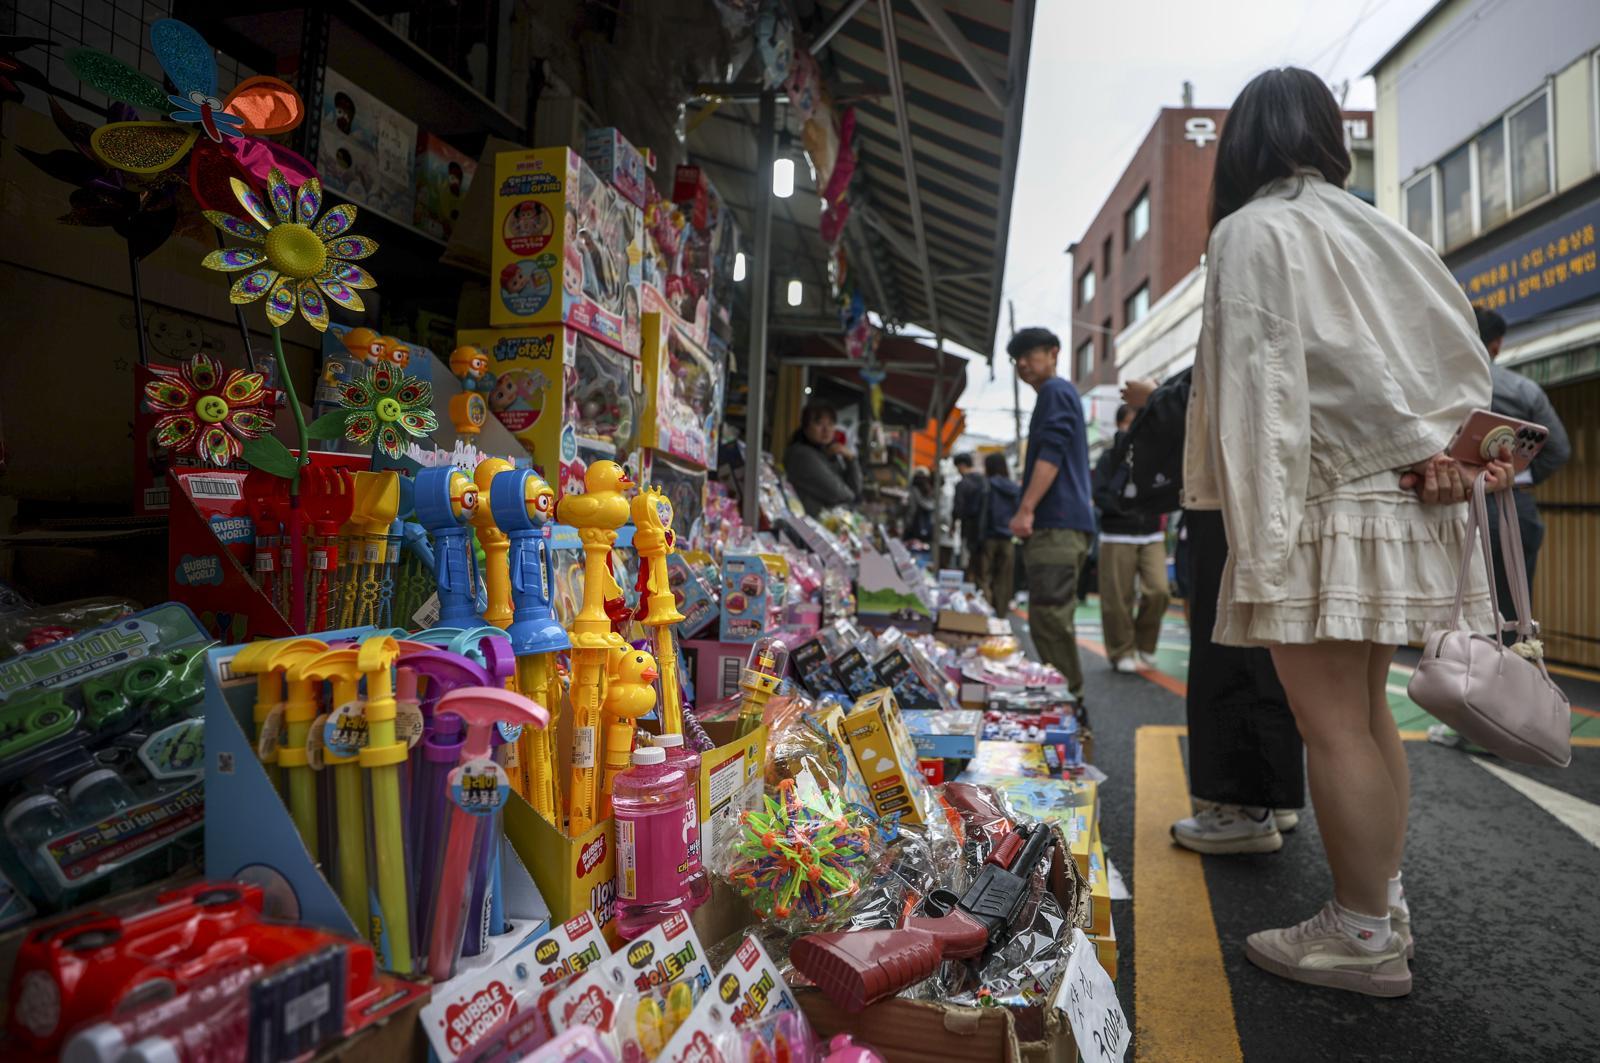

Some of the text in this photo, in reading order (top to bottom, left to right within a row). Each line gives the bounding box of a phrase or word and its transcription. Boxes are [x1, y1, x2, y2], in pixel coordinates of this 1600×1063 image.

[216, 528, 250, 543] WORLD
[183, 558, 217, 573] BUBBLE
[186, 568, 216, 585] WORLD
[582, 836, 604, 864] BUBBLE
[584, 847, 603, 872] WORLD
[566, 913, 589, 933] SEJU
[662, 911, 684, 934] SEJU
[536, 941, 558, 961] MINI
[627, 941, 653, 964] MINI
[721, 975, 739, 1000] MINI
[451, 985, 503, 1035] BUBBLE
[465, 1002, 505, 1046] WORLD
